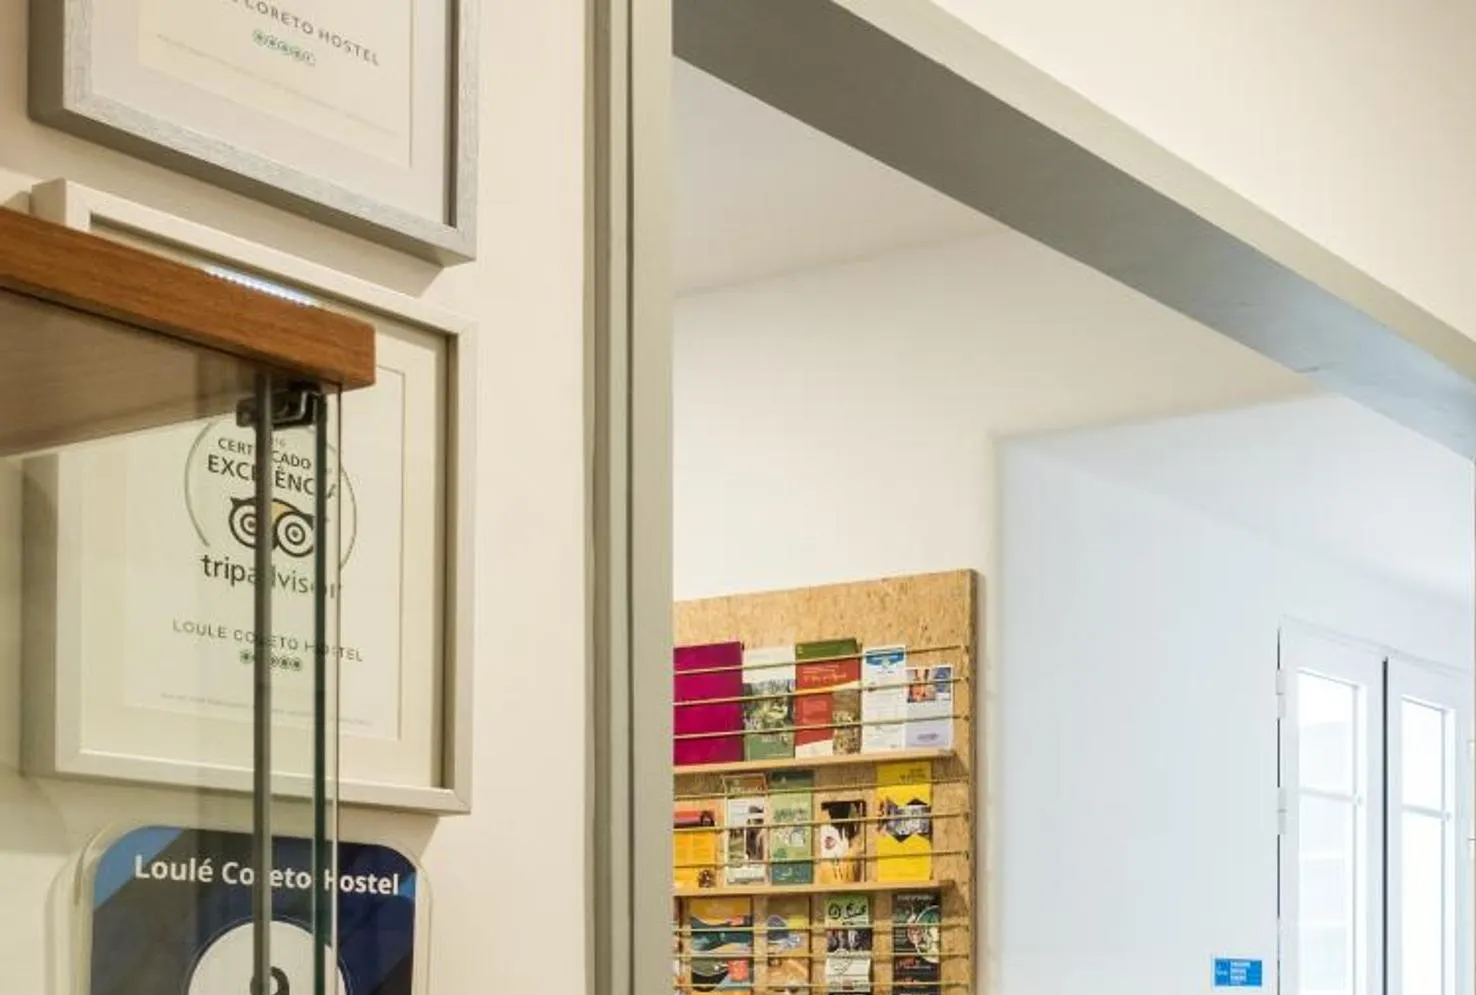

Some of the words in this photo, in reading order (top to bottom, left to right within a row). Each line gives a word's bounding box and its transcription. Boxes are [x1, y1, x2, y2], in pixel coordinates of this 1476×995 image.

[317, 28, 381, 67] HOSTEL
[217, 437, 312, 470] CERTCADO
[172, 618, 229, 639] LOULE
[233, 628, 299, 651] COETO
[133, 855, 214, 883] Loulé
[221, 861, 313, 890] Coeto
[323, 869, 400, 896] Hostel
